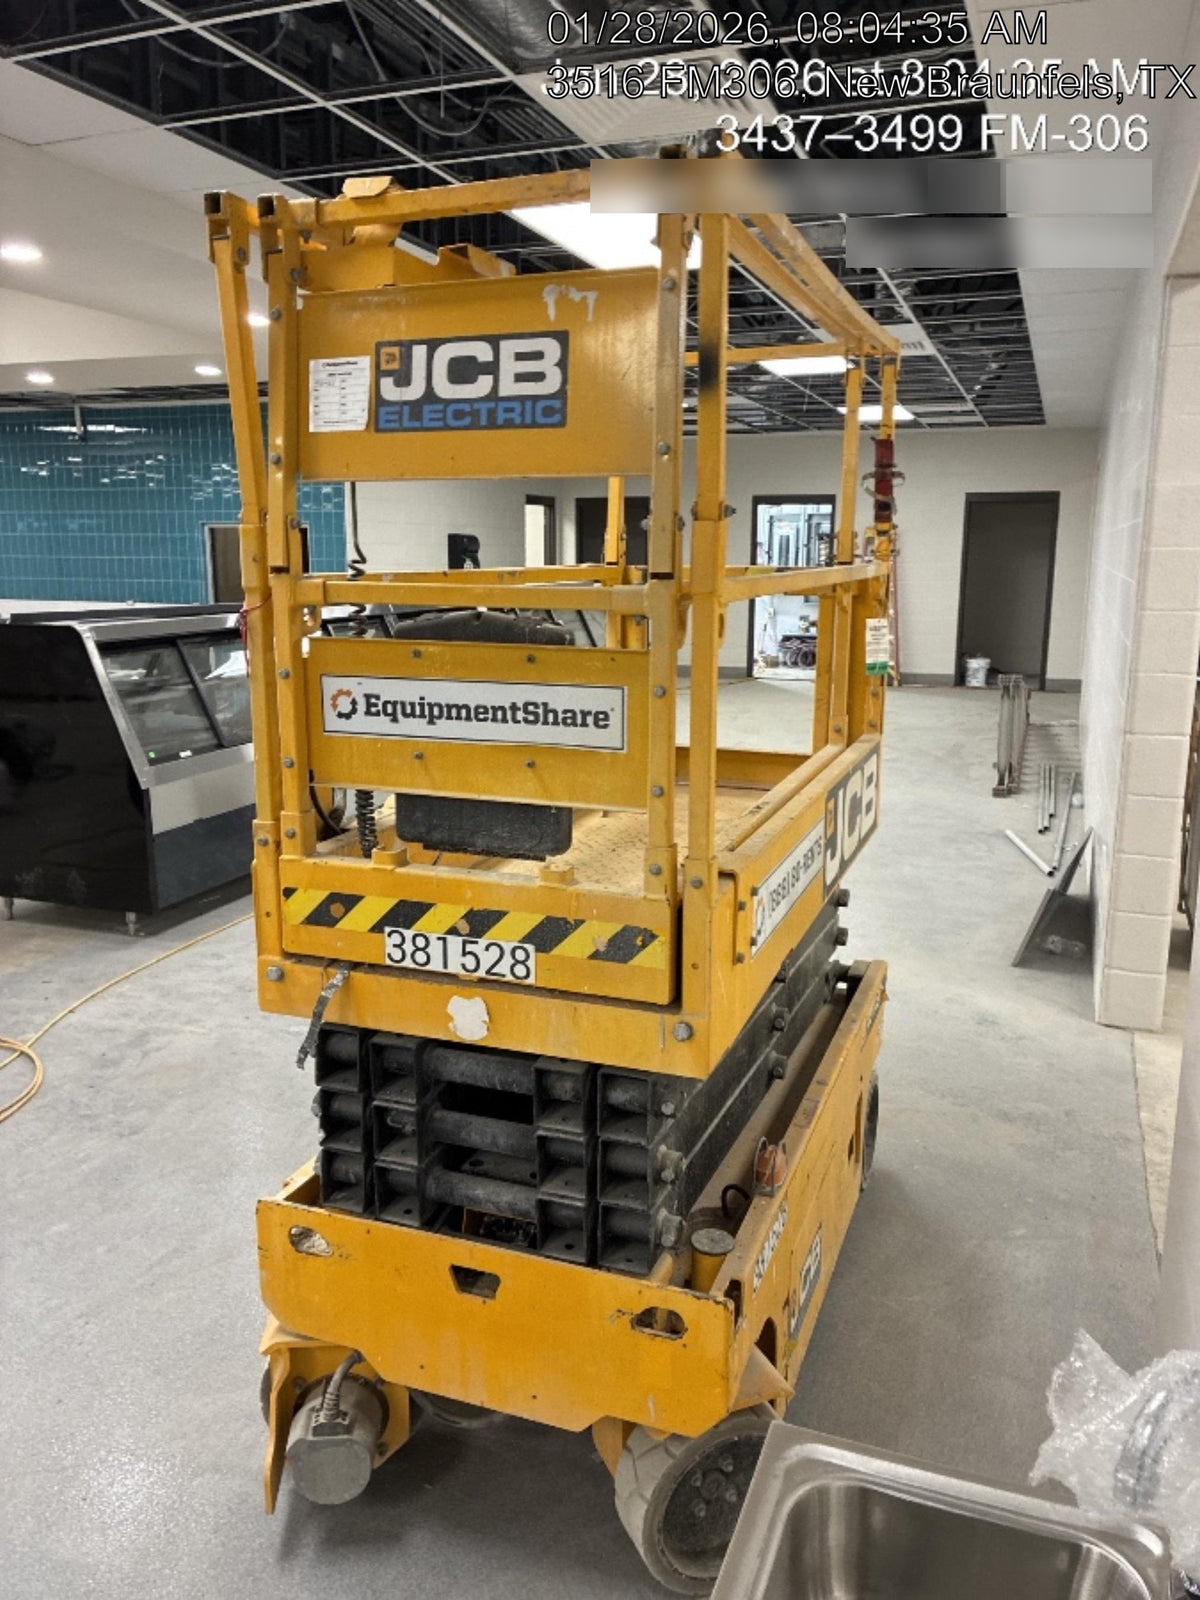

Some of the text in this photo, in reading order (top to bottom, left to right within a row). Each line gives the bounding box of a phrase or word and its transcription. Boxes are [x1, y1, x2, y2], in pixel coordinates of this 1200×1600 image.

[379, 337, 562, 401] JCB
[377, 400, 562, 430] ELECTRIC
[363, 693, 610, 729] EquipmentShare
[825, 753, 877, 887] JCB
[386, 929, 531, 980] 381528
